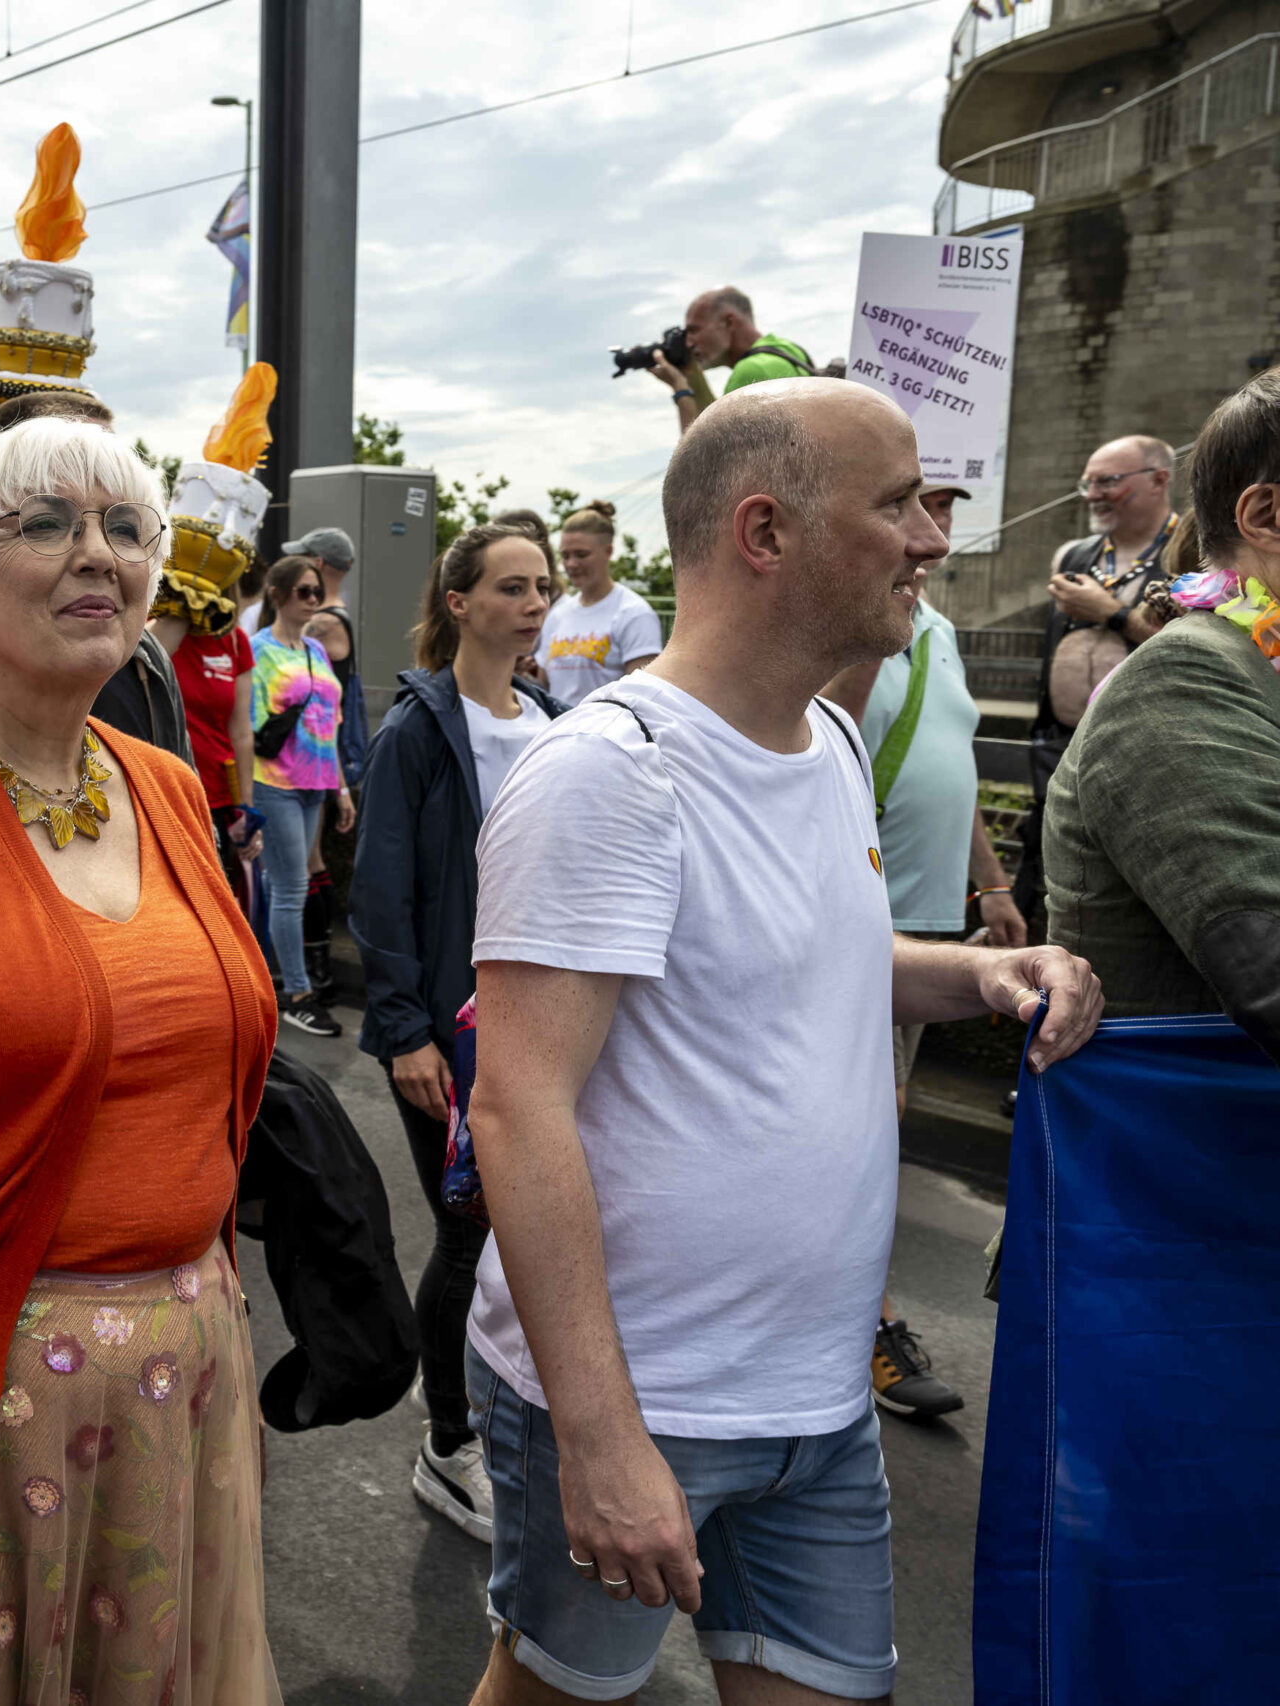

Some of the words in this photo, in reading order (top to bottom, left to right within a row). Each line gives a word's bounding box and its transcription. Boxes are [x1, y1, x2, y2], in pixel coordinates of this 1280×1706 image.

[958, 245, 1010, 271] BISS
[878, 339, 969, 385] ERGÄNZUNG
[923, 327, 1007, 370] SCHÜTZEN!
[852, 358, 885, 382] ART.
[889, 372, 899, 386] 3
[901, 377, 923, 396] GG
[924, 387, 975, 416] JETZT!
